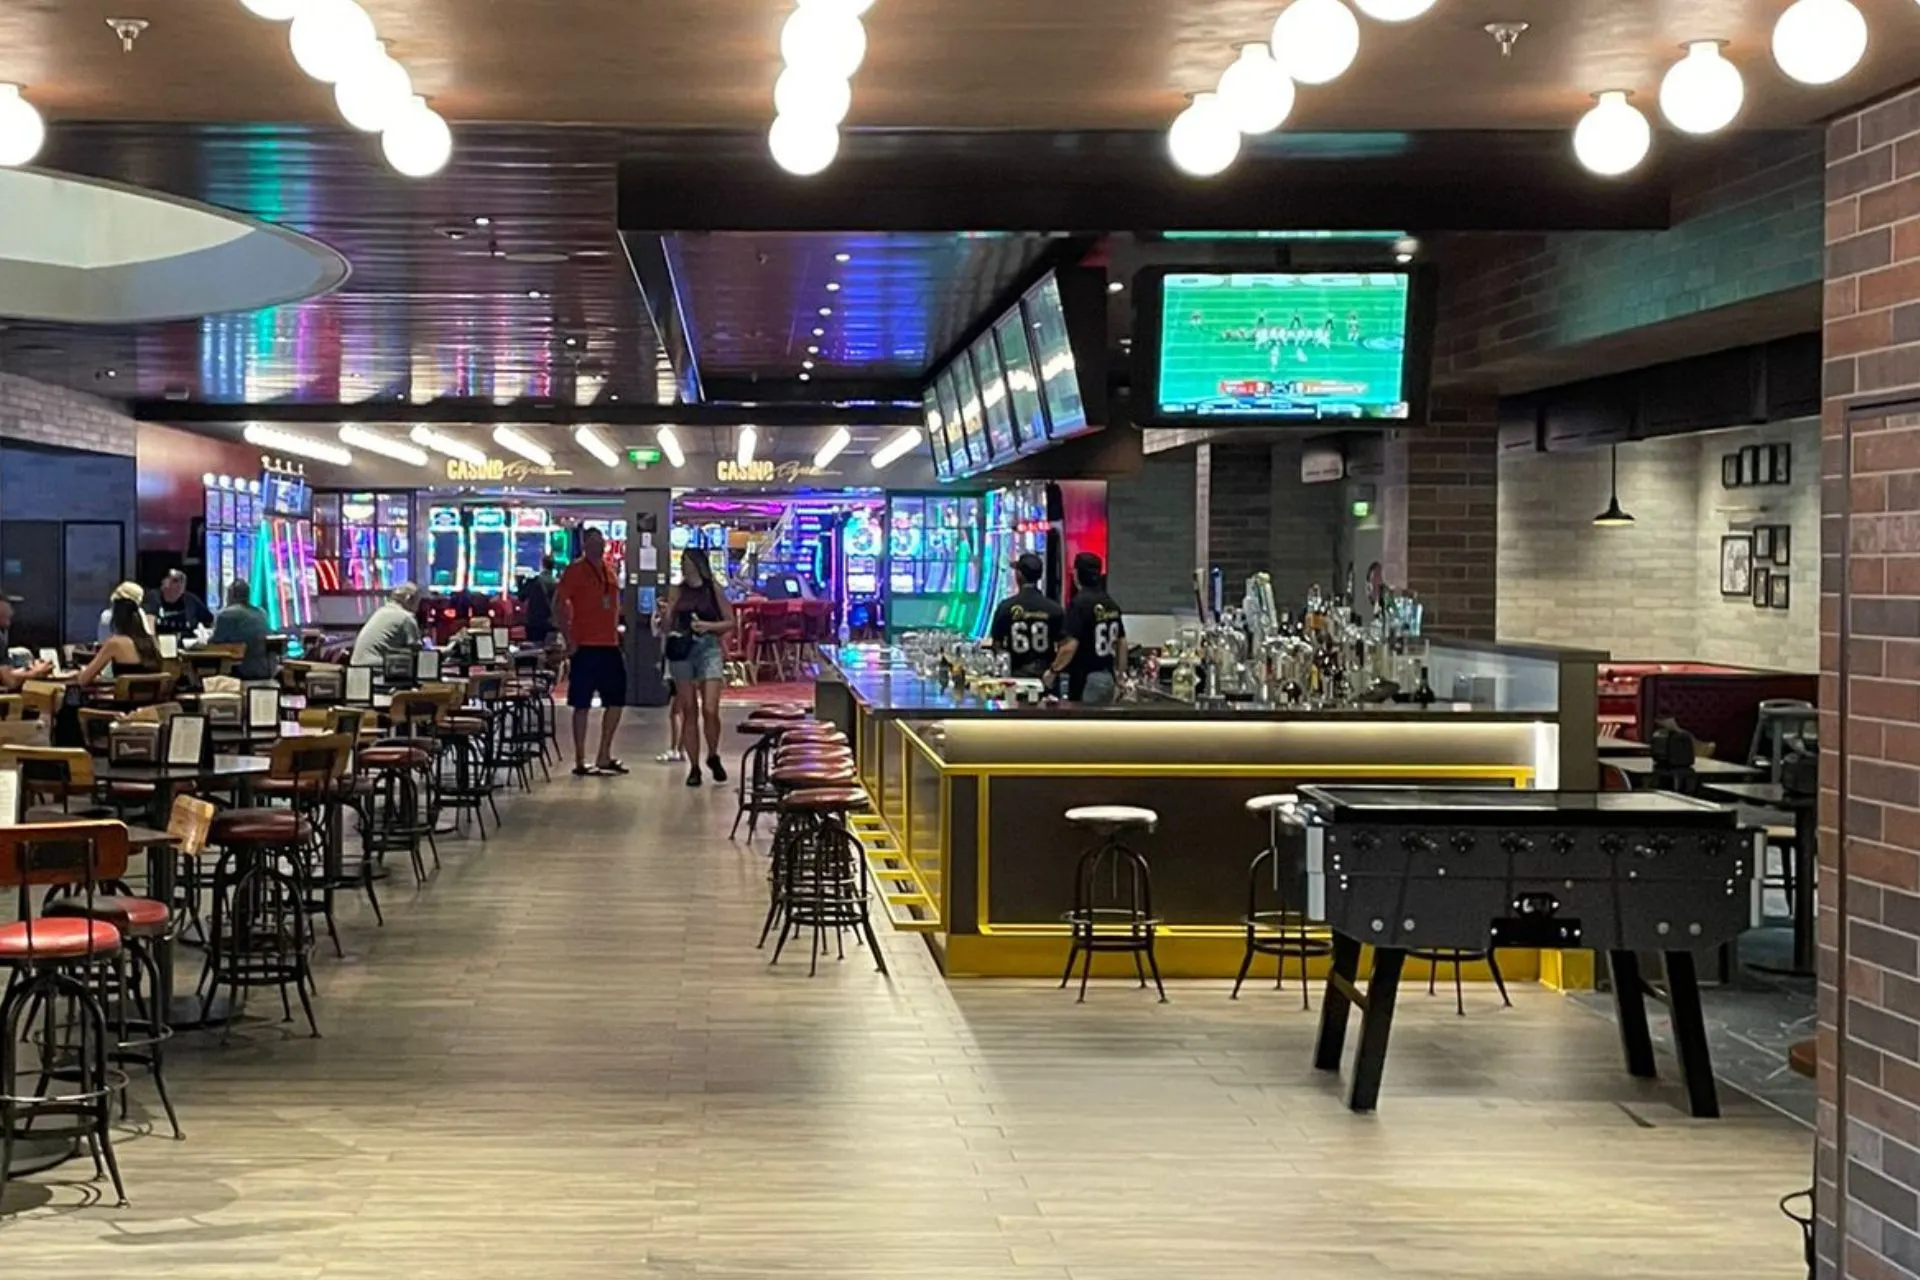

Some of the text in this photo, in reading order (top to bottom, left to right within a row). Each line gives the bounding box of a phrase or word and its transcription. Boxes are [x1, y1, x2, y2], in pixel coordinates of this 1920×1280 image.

[446, 459, 504, 480] CASINO
[717, 460, 774, 481] CASINO
[1011, 620, 1049, 653] 68
[1095, 621, 1119, 657] 68
